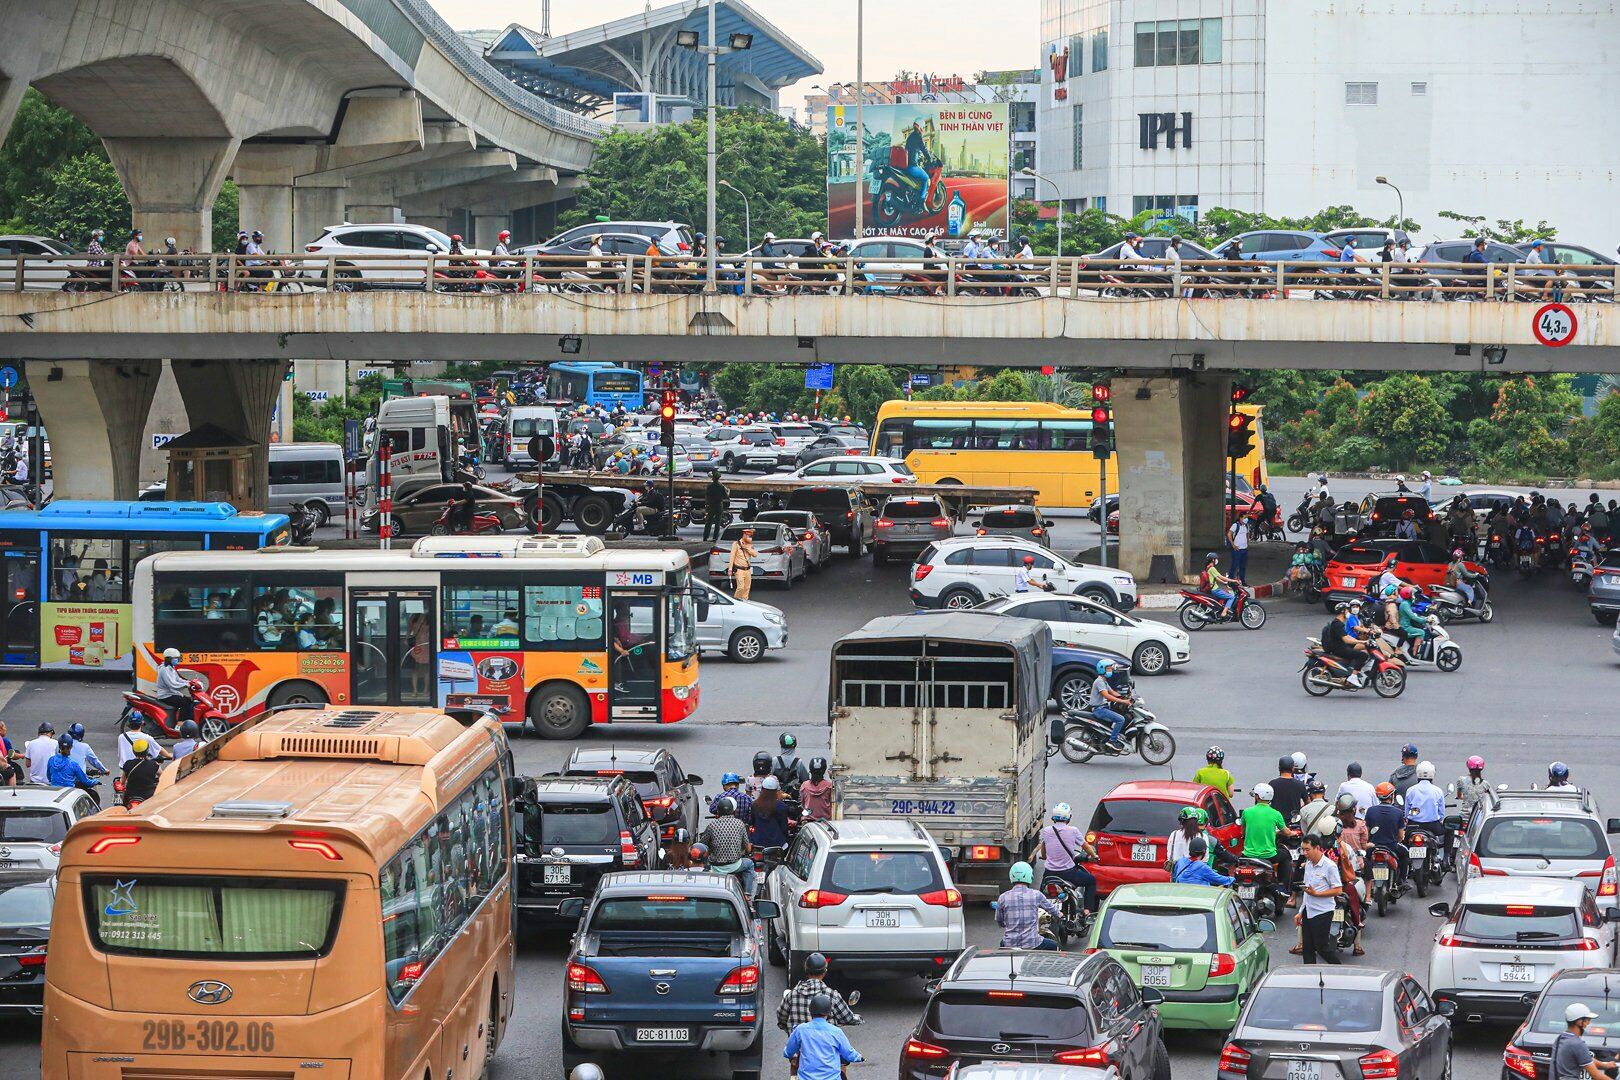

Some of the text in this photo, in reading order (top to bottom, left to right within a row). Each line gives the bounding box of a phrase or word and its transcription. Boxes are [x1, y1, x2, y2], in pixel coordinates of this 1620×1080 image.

[940, 123, 959, 131] TINH
[987, 121, 1004, 132] VIỆT
[1137, 112, 1192, 149] IPH
[878, 228, 888, 236] XE
[890, 226, 908, 236] MÁY
[909, 228, 927, 236] CAO
[154, 436, 176, 447] P2
[633, 574, 653, 585] MB
[892, 800, 955, 815] 29C-944.22
[551, 866, 564, 875] 30E
[111, 931, 130, 939] 0912
[132, 932, 146, 940] 313
[147, 932, 161, 940] 445
[1144, 975, 1168, 985] 5055
[1503, 973, 1531, 981] 594.41
[143, 1019, 274, 1053] 29B-302.06
[638, 1029, 688, 1041] 29C-811.03
[1296, 1062, 1313, 1072] 30A
